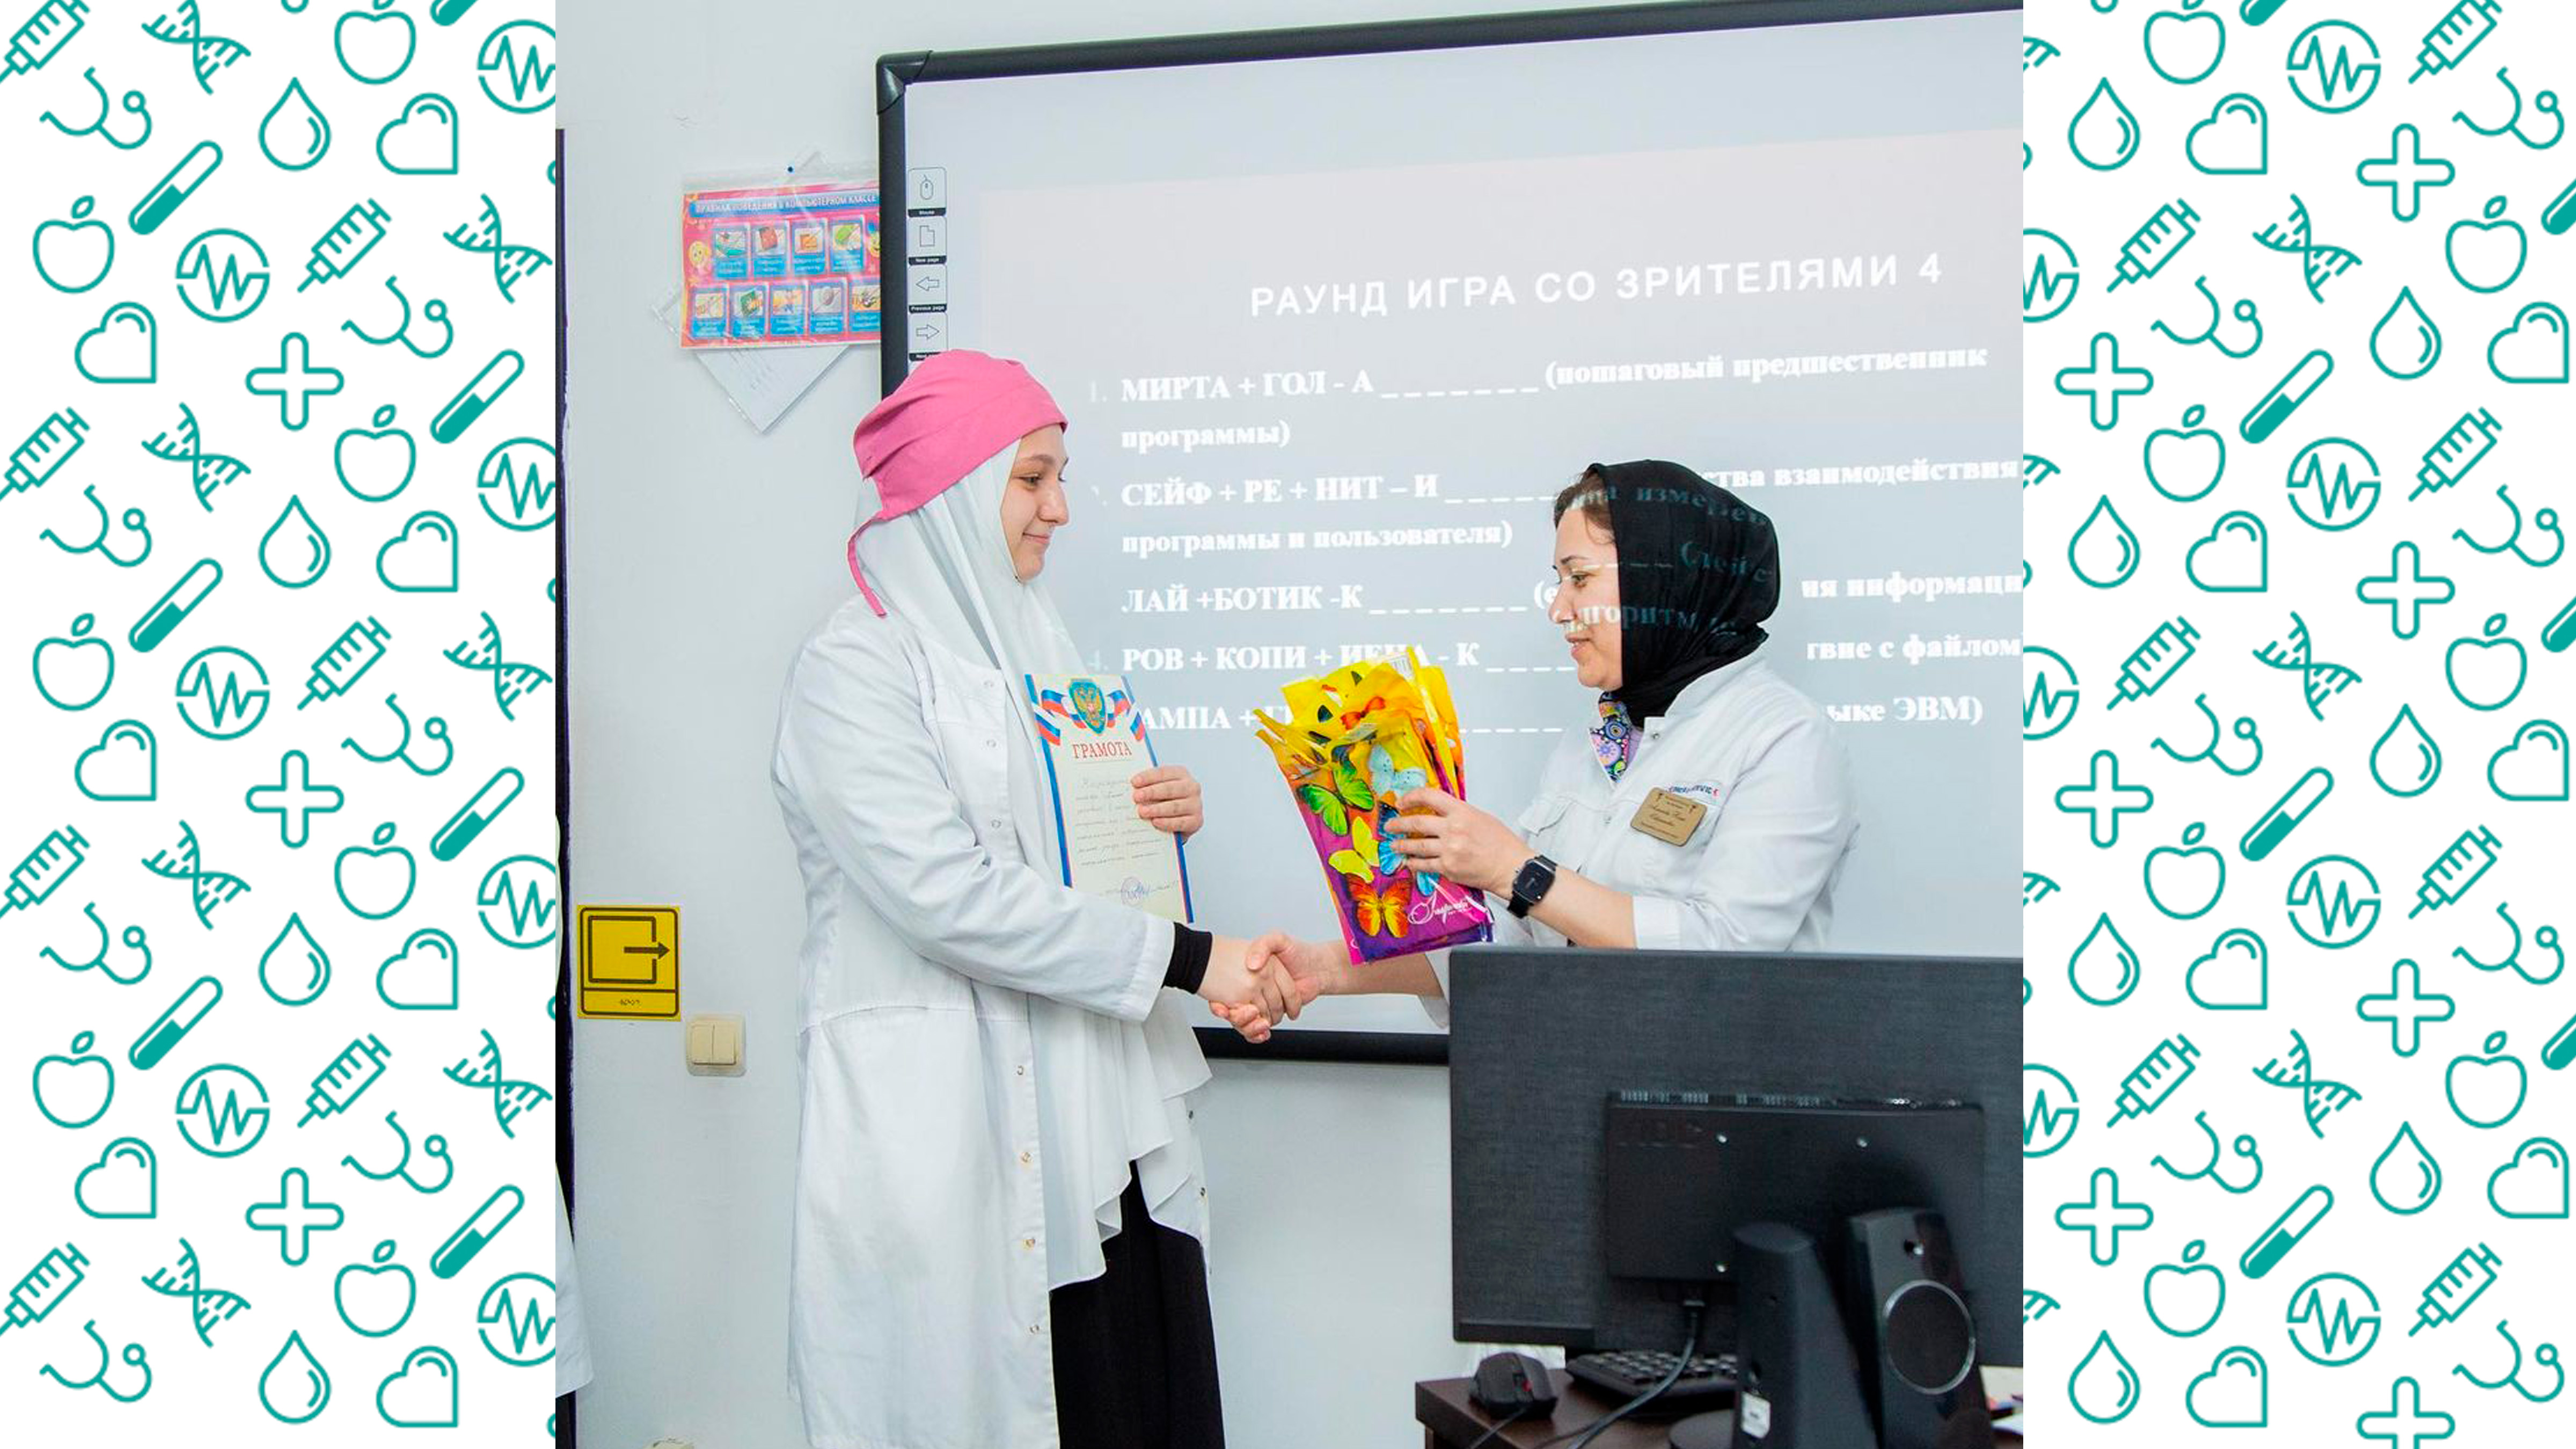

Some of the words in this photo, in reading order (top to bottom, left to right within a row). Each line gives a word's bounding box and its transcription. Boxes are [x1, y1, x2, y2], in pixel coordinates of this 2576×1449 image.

[1252, 281, 1387, 317] РАУНД
[1408, 275, 1516, 309] ИГРА
[1535, 271, 1596, 303] СО
[1616, 255, 1897, 299] ЗРИТЕЛЯМИ
[1919, 253, 1942, 283] 4
[1121, 376, 1231, 402] МИРТА
[1238, 378, 1255, 395] +
[1262, 371, 1328, 396] ГОЛ
[1351, 369, 1374, 393] А
[1545, 355, 1723, 390] (пошаговый
[1732, 348, 1988, 383] предшественник
[1121, 420, 1290, 454] программы)
[1121, 476, 1212, 506] СЕЙФ
[1219, 484, 1237, 501] +
[1243, 479, 1283, 503] РЕ
[1290, 482, 1308, 500] +
[1315, 476, 1384, 501] НИТ
[1414, 473, 1440, 498] И
[1774, 458, 2019, 487] взаимодействия
[1122, 532, 1281, 559] программы
[1288, 532, 1305, 549] и
[1313, 520, 1513, 550] пользователя)
[1121, 583, 1189, 613] ЛАЙ
[1196, 586, 1323, 612] +БОТИК
[1121, 647, 1184, 671] РОВ
[1190, 651, 1208, 669] +
[1216, 646, 1306, 670] КОПИ
[1314, 648, 1333, 666] +
[1456, 642, 1481, 665] К
[1878, 641, 1895, 658] с
[1902, 632, 2023, 665] файлом
[1142, 705, 1232, 730] АМПА
[1892, 695, 1984, 726] ЭВМ)
[1072, 741, 1132, 758] ГРАМОТА
